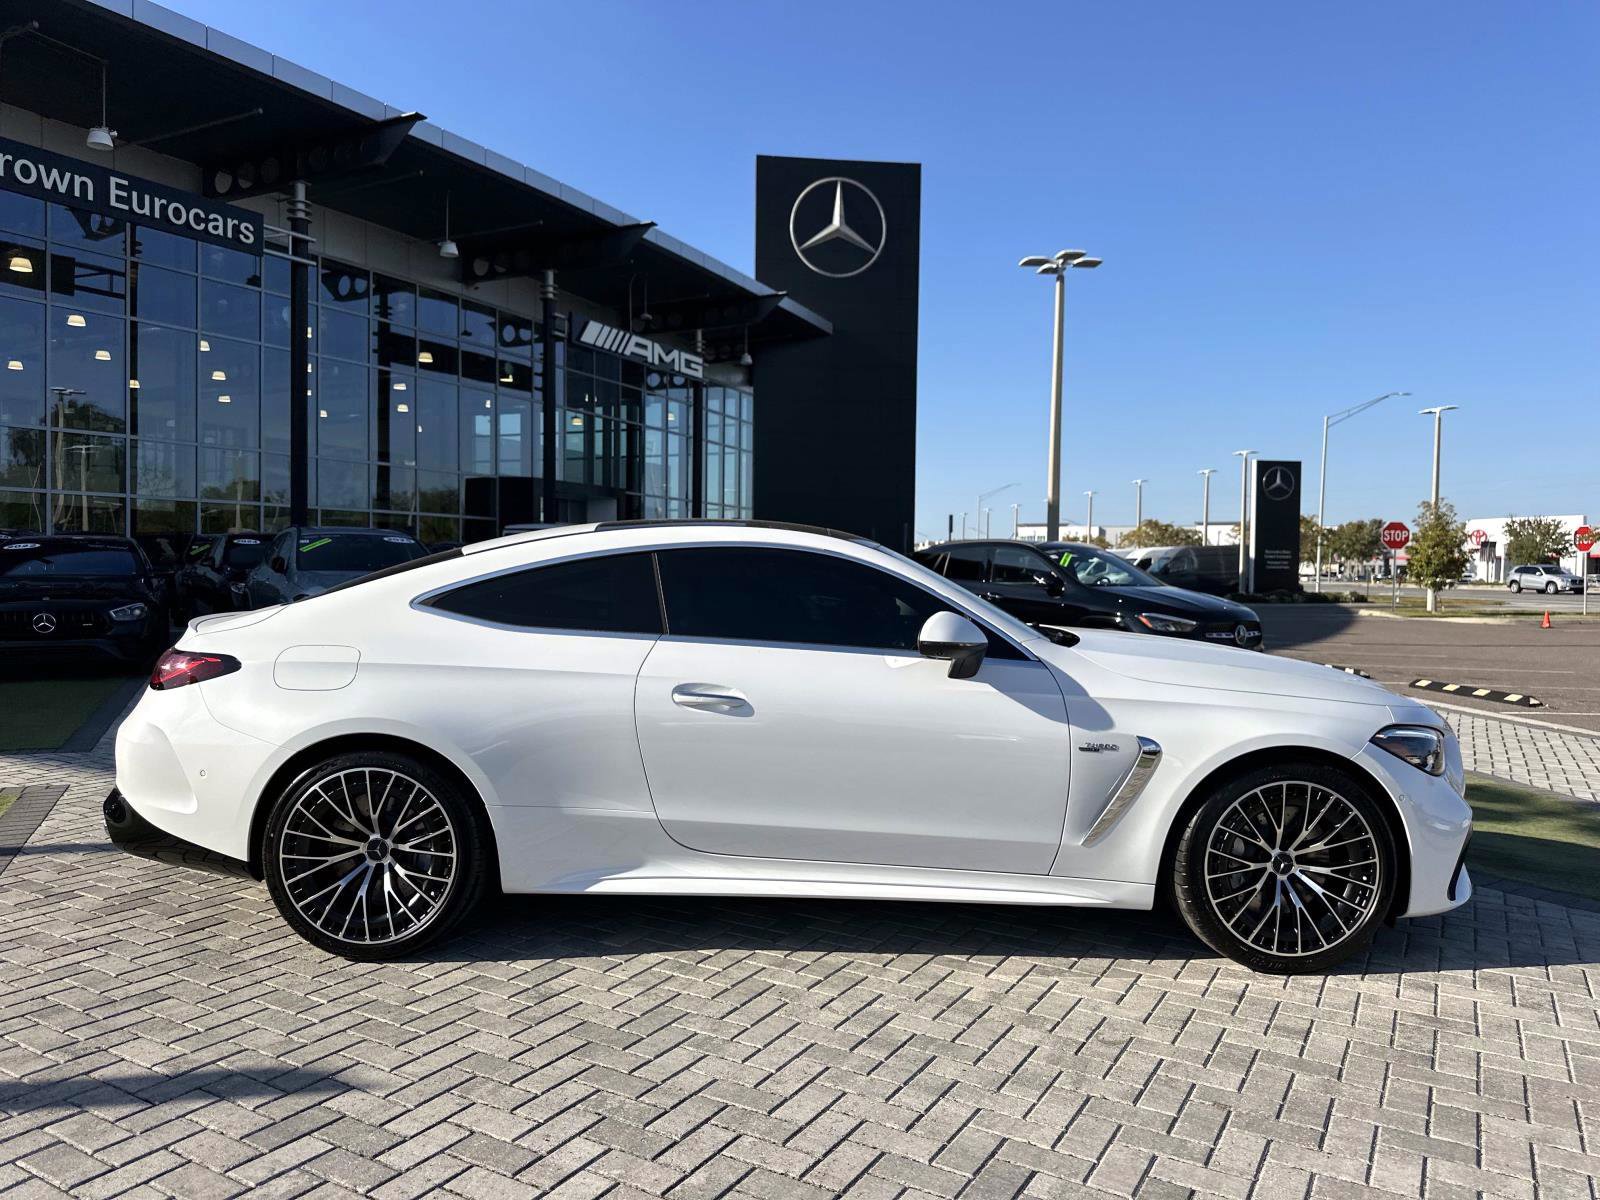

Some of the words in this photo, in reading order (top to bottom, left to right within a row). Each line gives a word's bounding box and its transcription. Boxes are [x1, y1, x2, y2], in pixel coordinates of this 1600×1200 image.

[0, 152, 94, 201] rown
[109, 176, 255, 244] Eurocars
[624, 334, 703, 378] AMG
[1383, 529, 1408, 542] STOP
